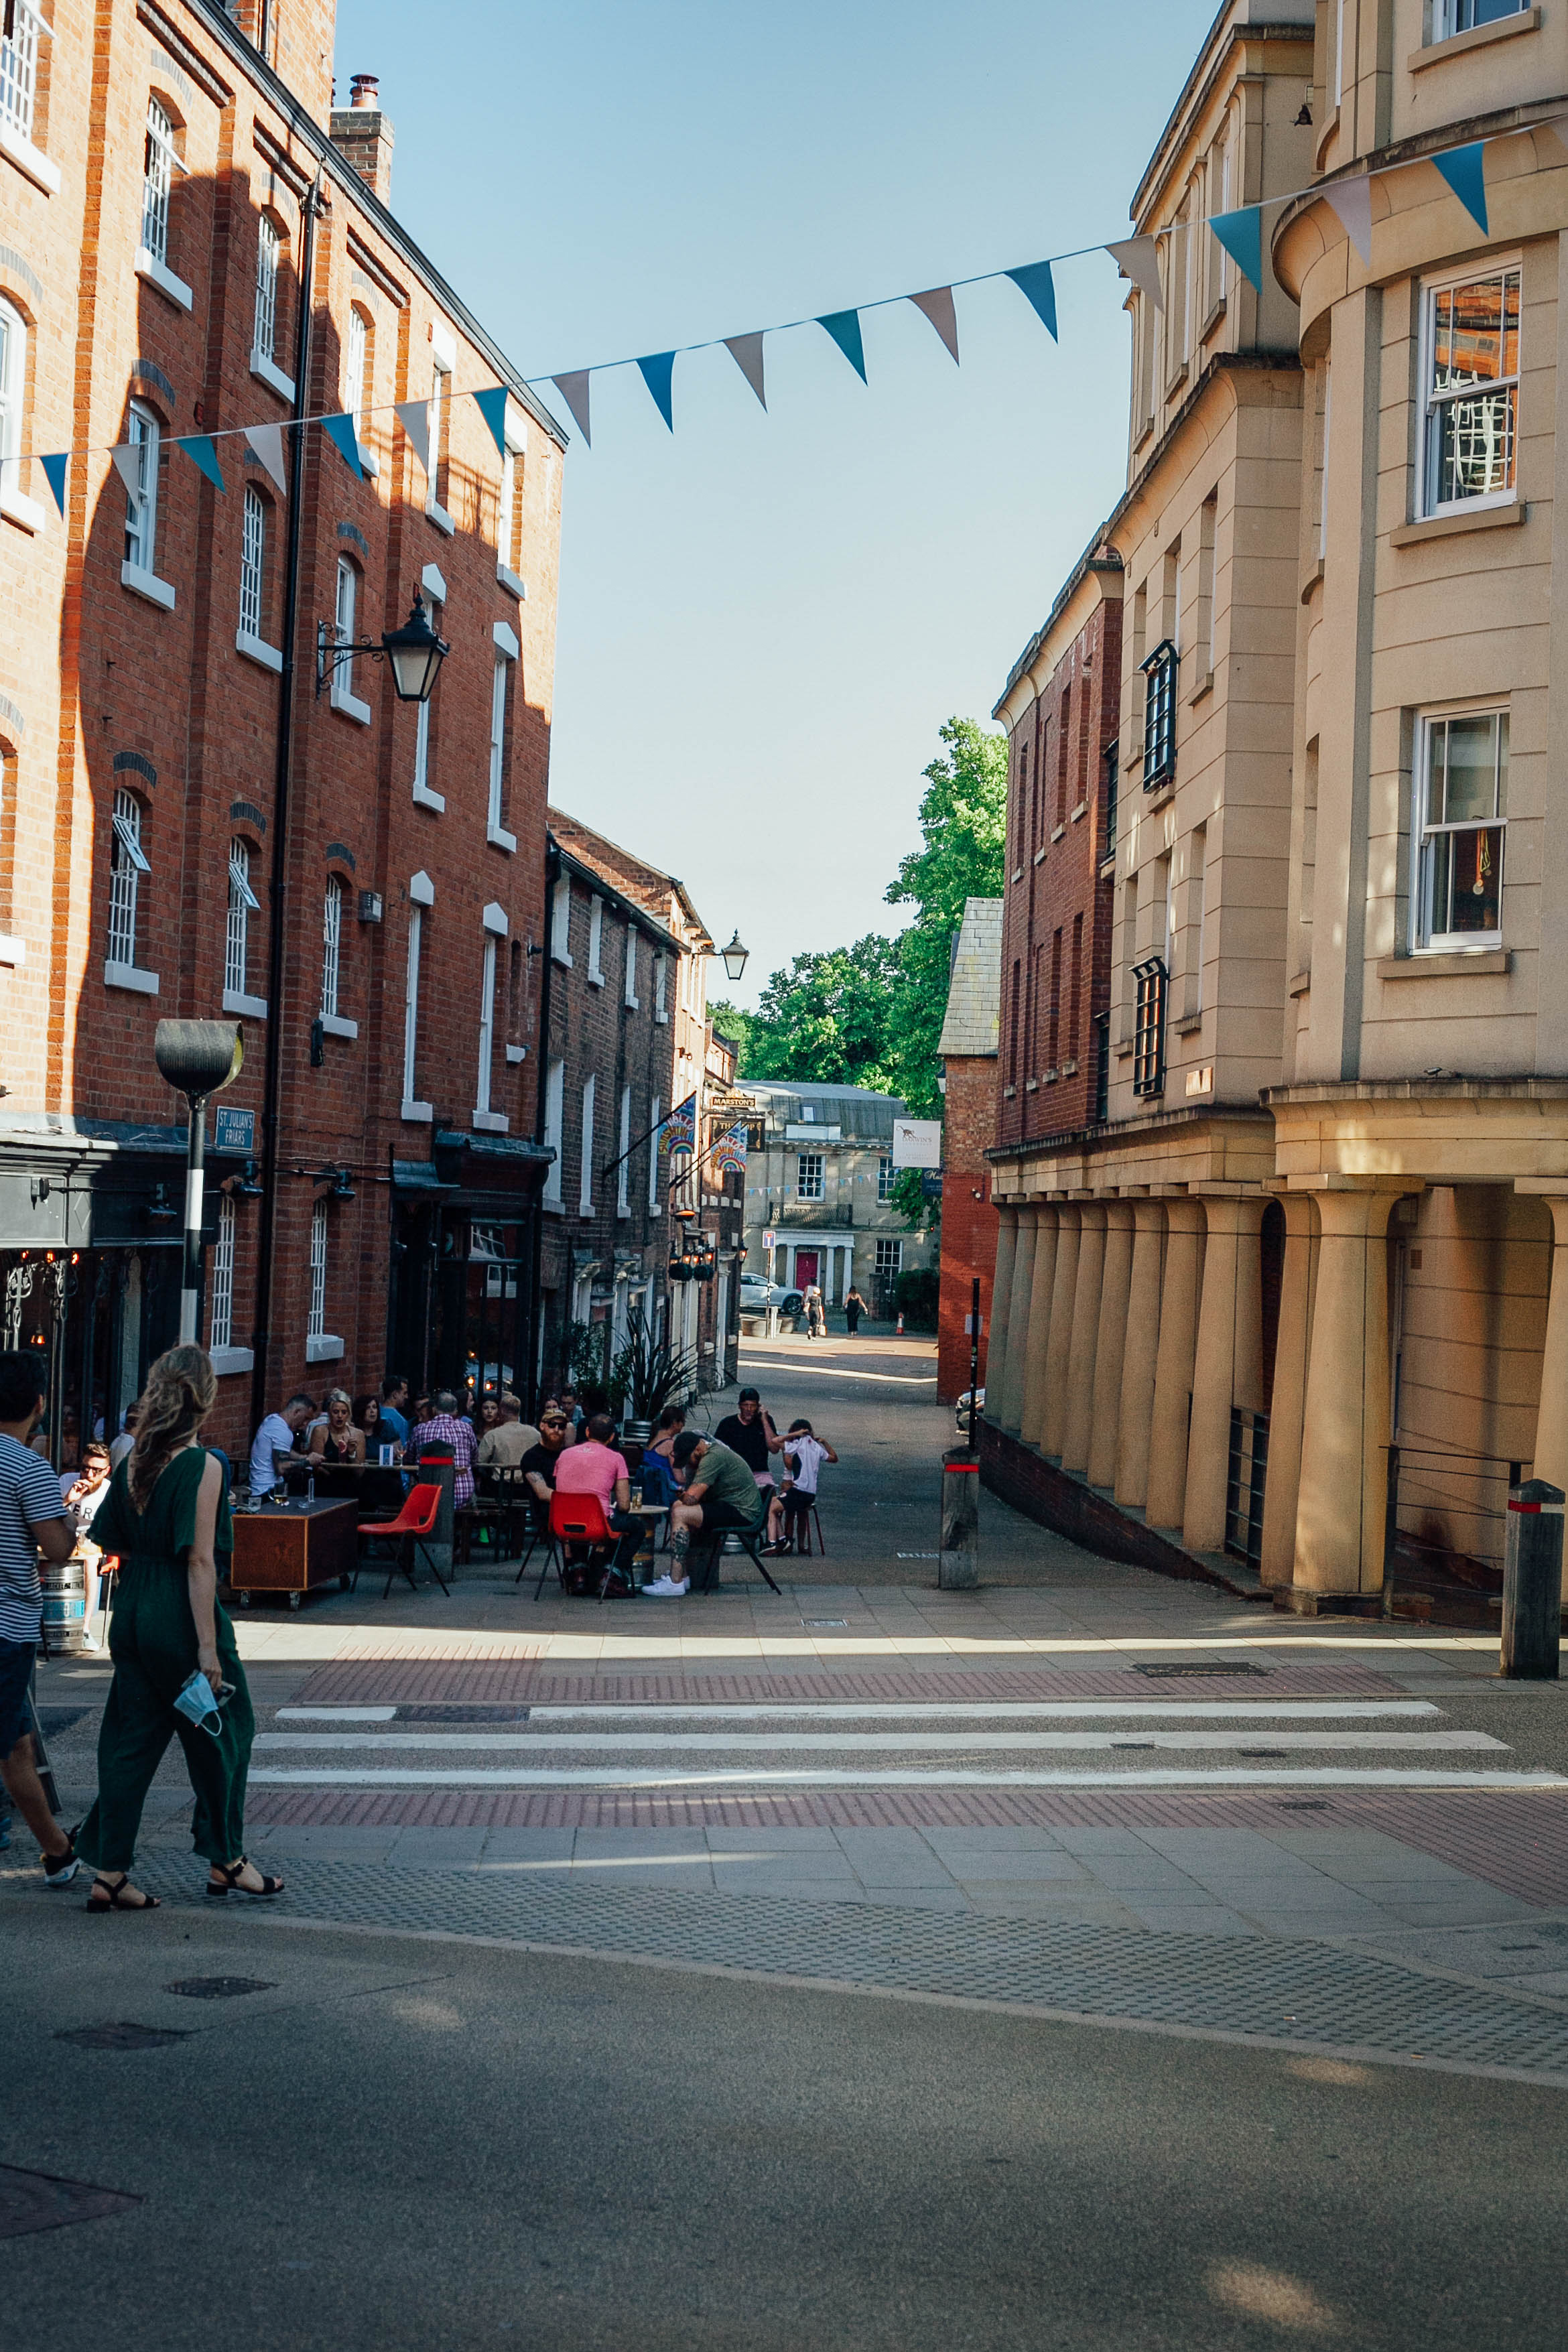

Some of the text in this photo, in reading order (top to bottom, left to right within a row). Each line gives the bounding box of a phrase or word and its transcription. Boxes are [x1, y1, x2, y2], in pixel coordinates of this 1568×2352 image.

[219, 1111, 253, 1130] ST. JULIAN'S
[225, 1129, 245, 1146] FRIARS
